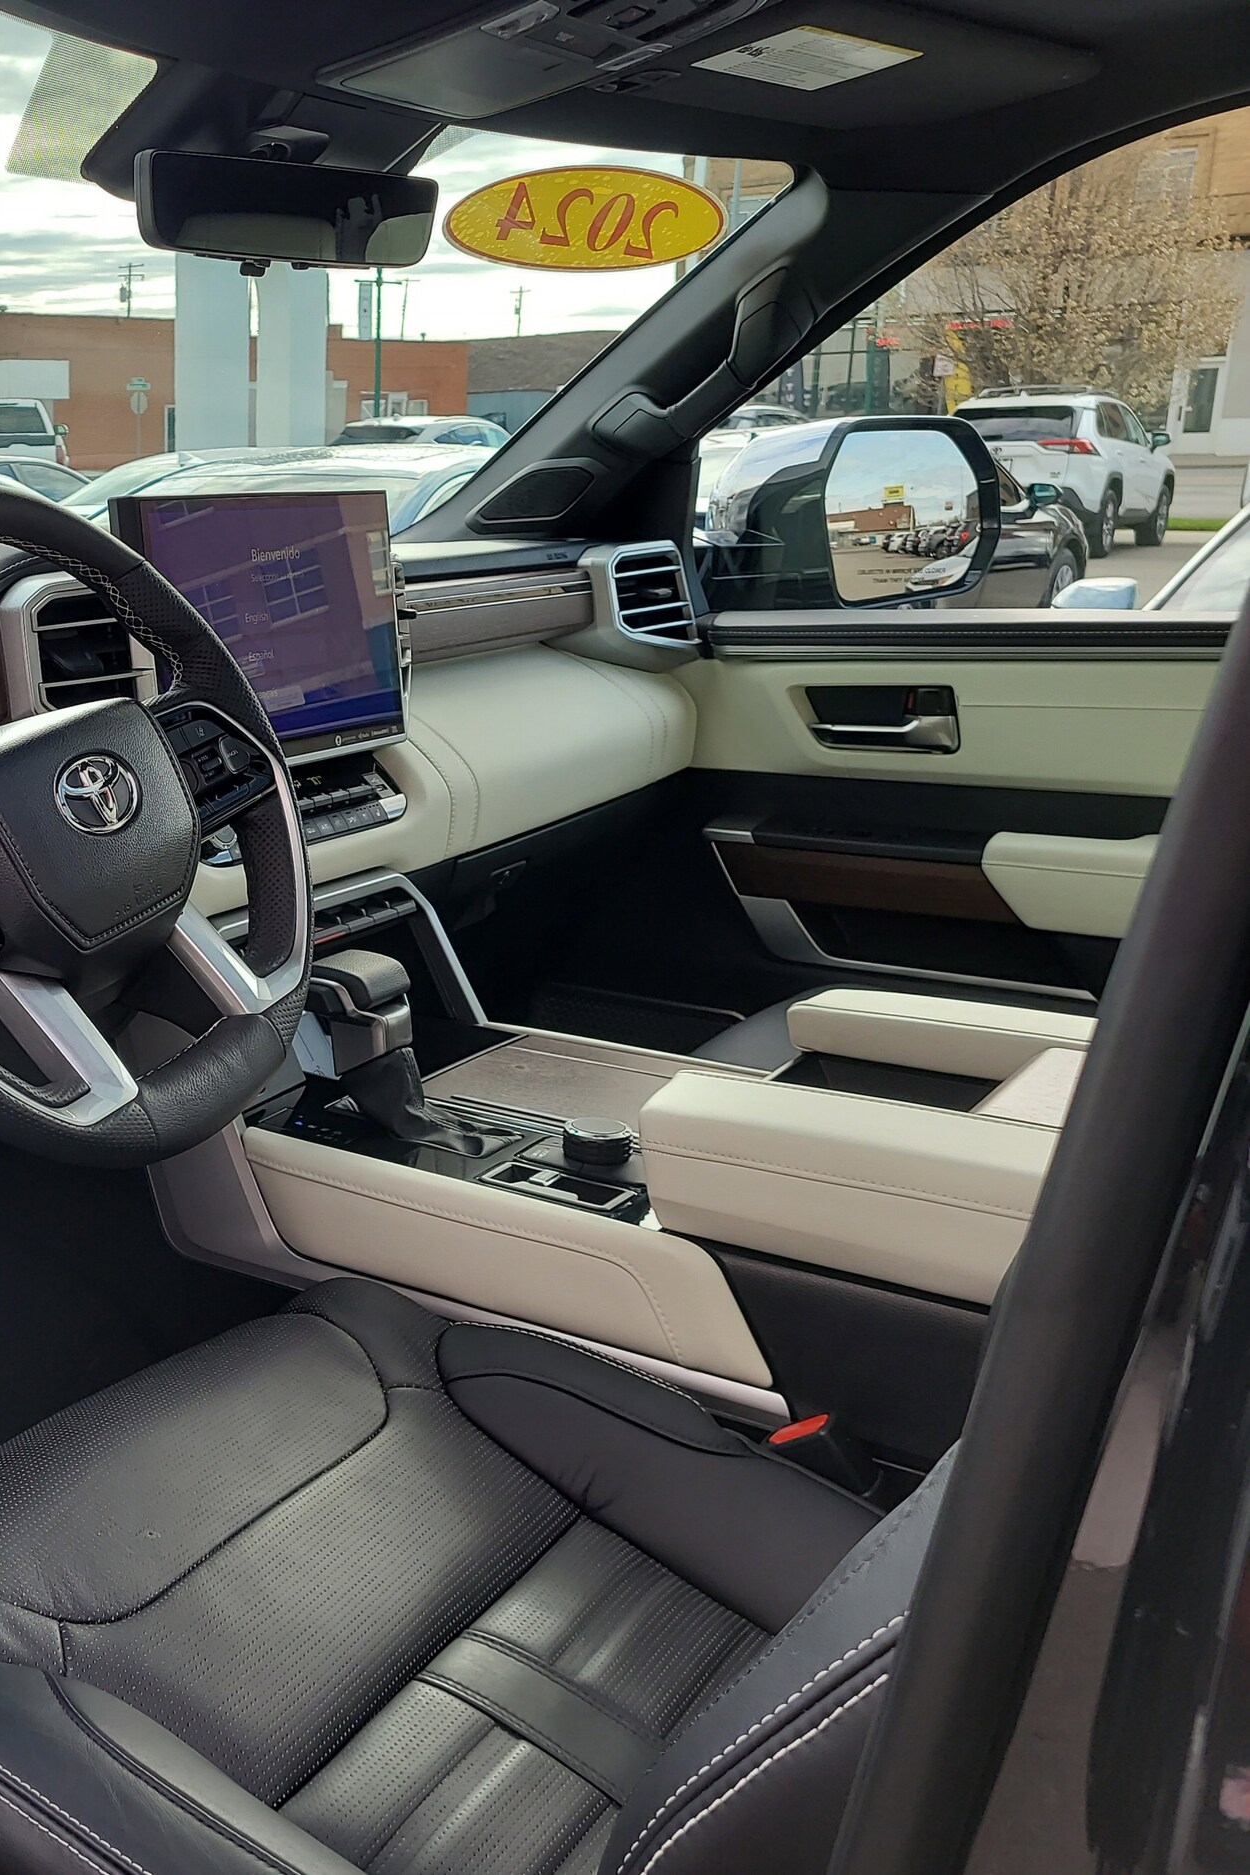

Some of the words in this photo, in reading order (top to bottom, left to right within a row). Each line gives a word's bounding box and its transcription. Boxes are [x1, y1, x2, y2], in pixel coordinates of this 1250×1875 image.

[251, 546, 300, 562] Bienvenido
[245, 611, 269, 625] English
[248, 649, 275, 663] Español
